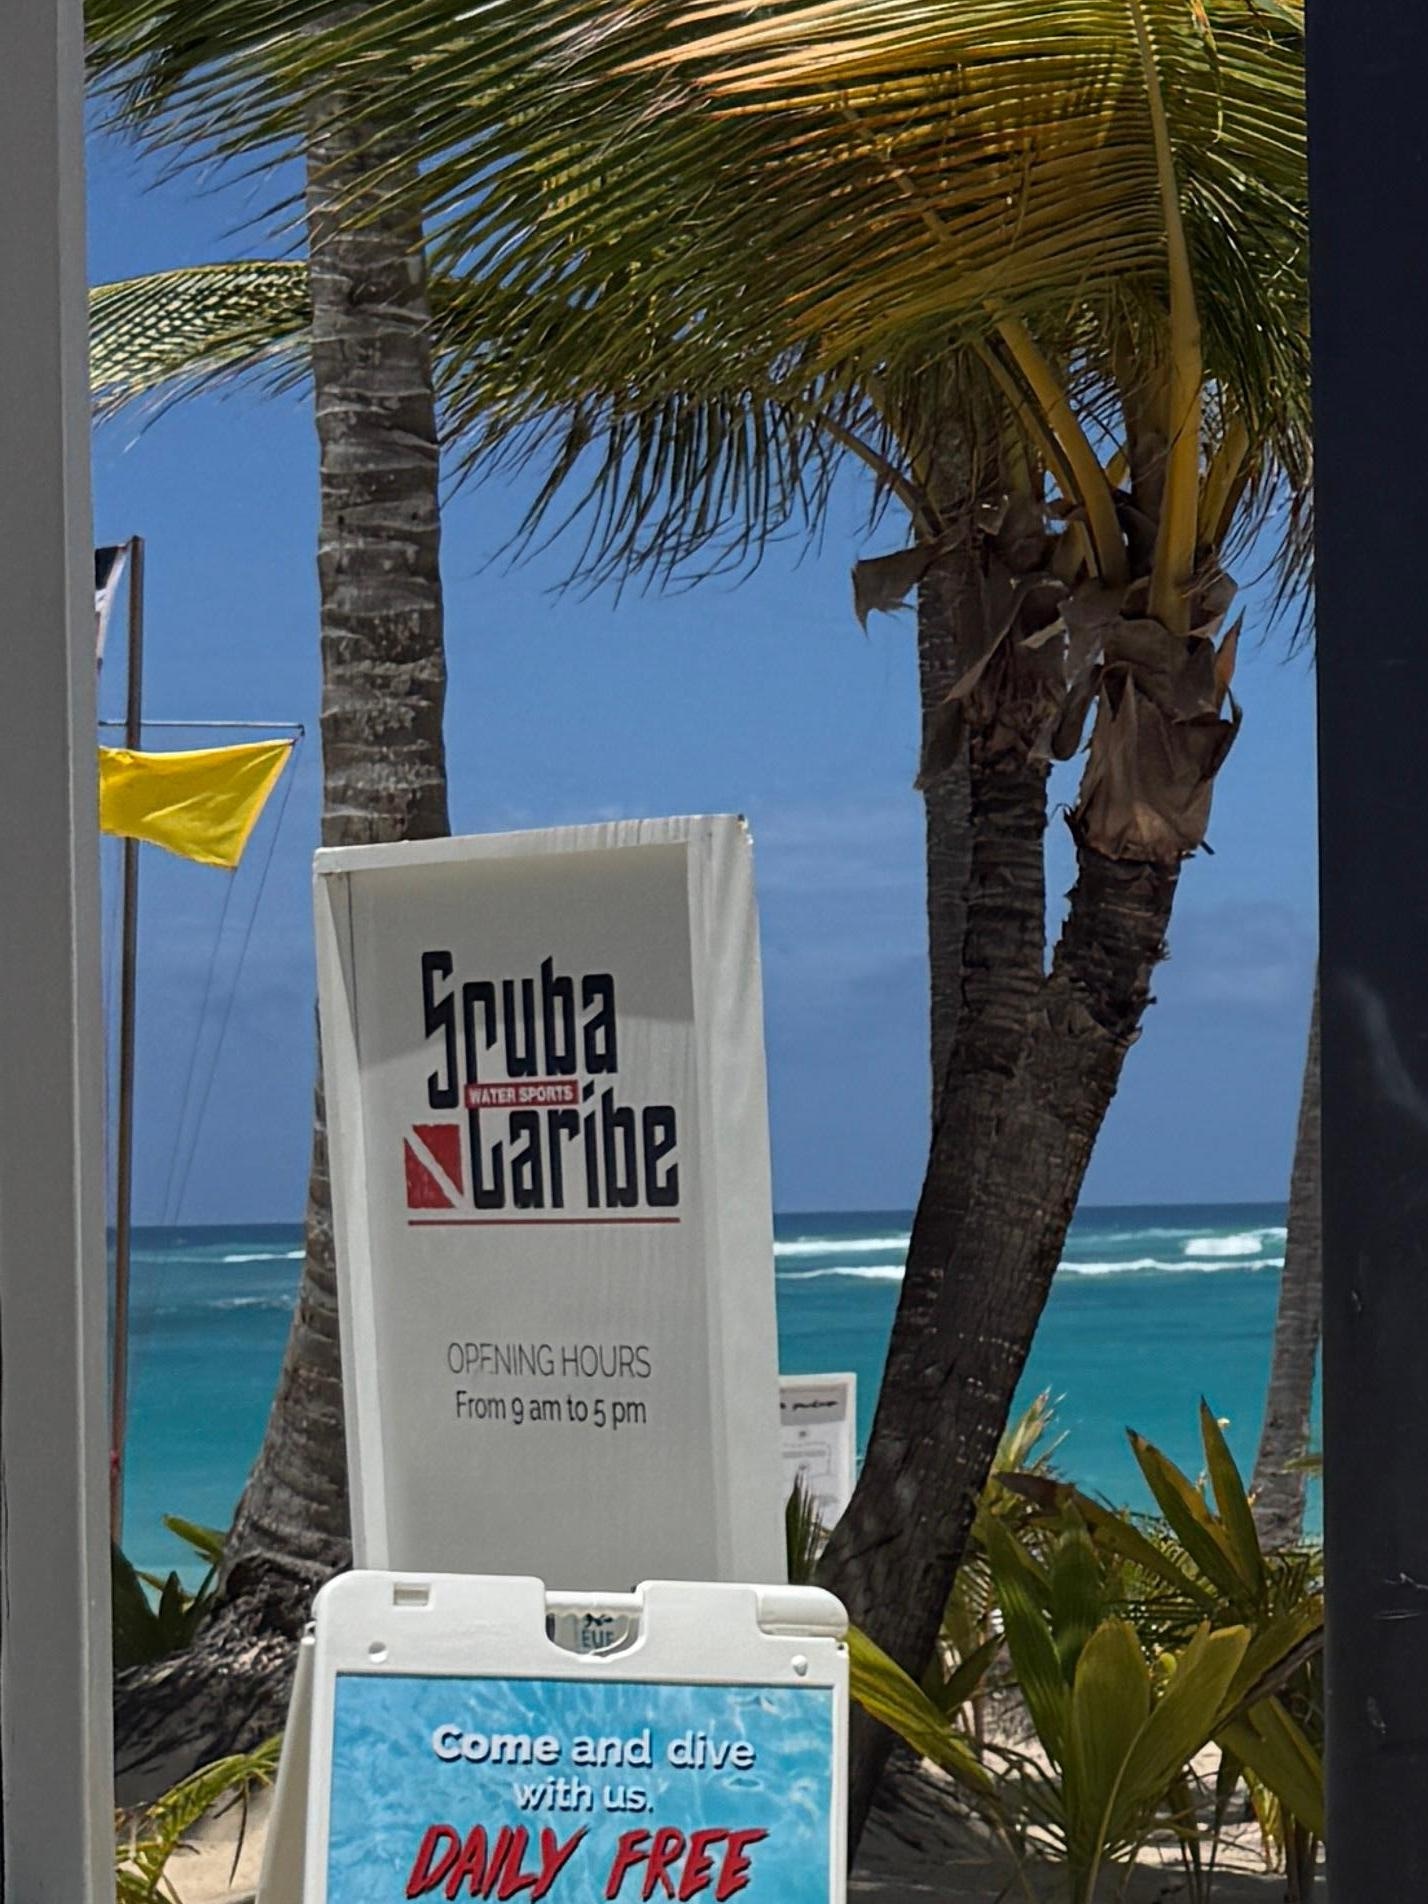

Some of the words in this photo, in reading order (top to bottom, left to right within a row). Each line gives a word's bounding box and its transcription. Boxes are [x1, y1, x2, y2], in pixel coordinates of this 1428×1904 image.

[422, 950, 618, 1109] Scuba
[469, 1087, 516, 1105] WATER
[518, 1085, 574, 1102] SPORTS
[468, 1079, 680, 1210] Caribe
[448, 1342, 555, 1376] OPENING
[561, 1344, 652, 1378] HOURS
[456, 1390, 506, 1420] From
[511, 1397, 524, 1425] 9
[529, 1398, 561, 1422] am
[566, 1395, 588, 1422] to
[593, 1399, 607, 1428] 5
[612, 1400, 647, 1430] pm
[432, 1723, 561, 1764] Come
[571, 1728, 652, 1767] and
[666, 1729, 756, 1770] dive
[513, 1775, 593, 1811] with
[603, 1782, 654, 1812] us.
[405, 1823, 589, 1904] DAILY
[605, 1826, 770, 1902] FREE
